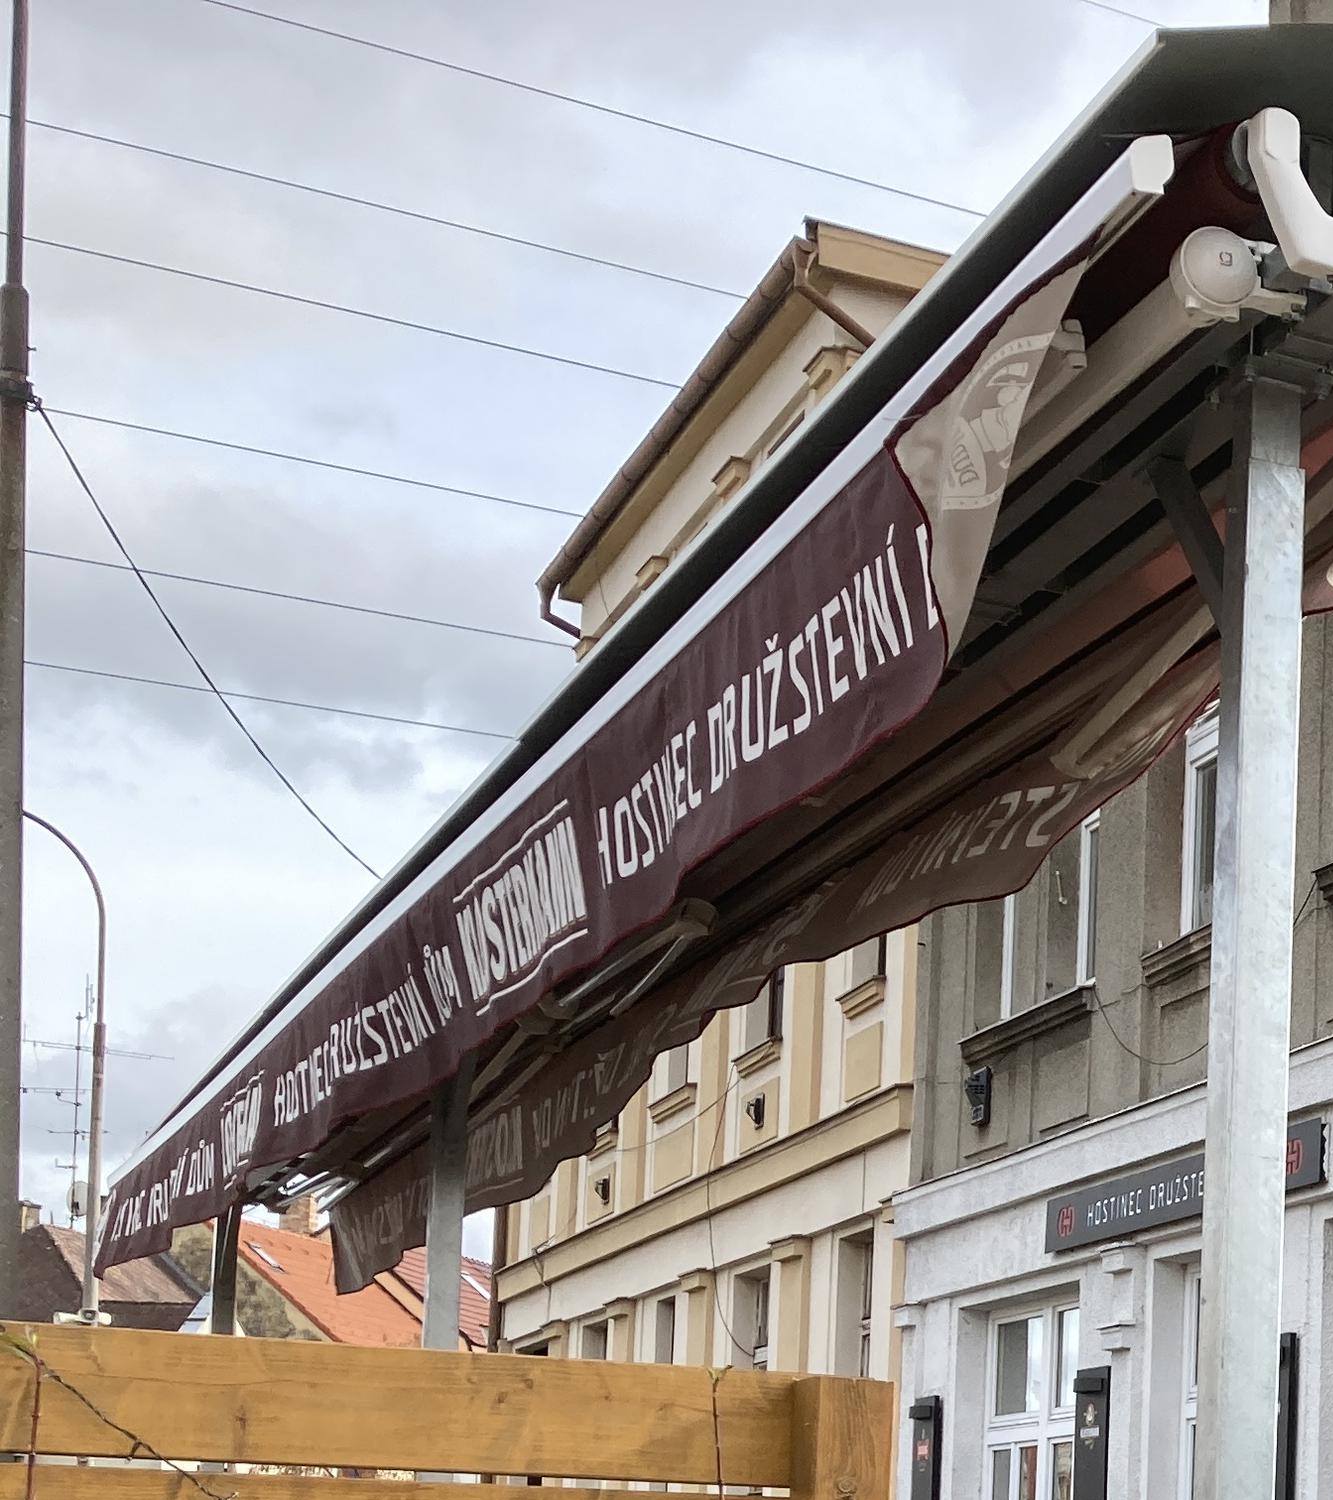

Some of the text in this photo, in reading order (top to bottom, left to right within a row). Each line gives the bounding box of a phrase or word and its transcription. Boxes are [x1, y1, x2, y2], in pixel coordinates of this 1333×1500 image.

[707, 523, 914, 795] DRUŽSTEVNÍ
[1087, 1171, 1205, 1227] HOSTINEC DRUŽSTE
